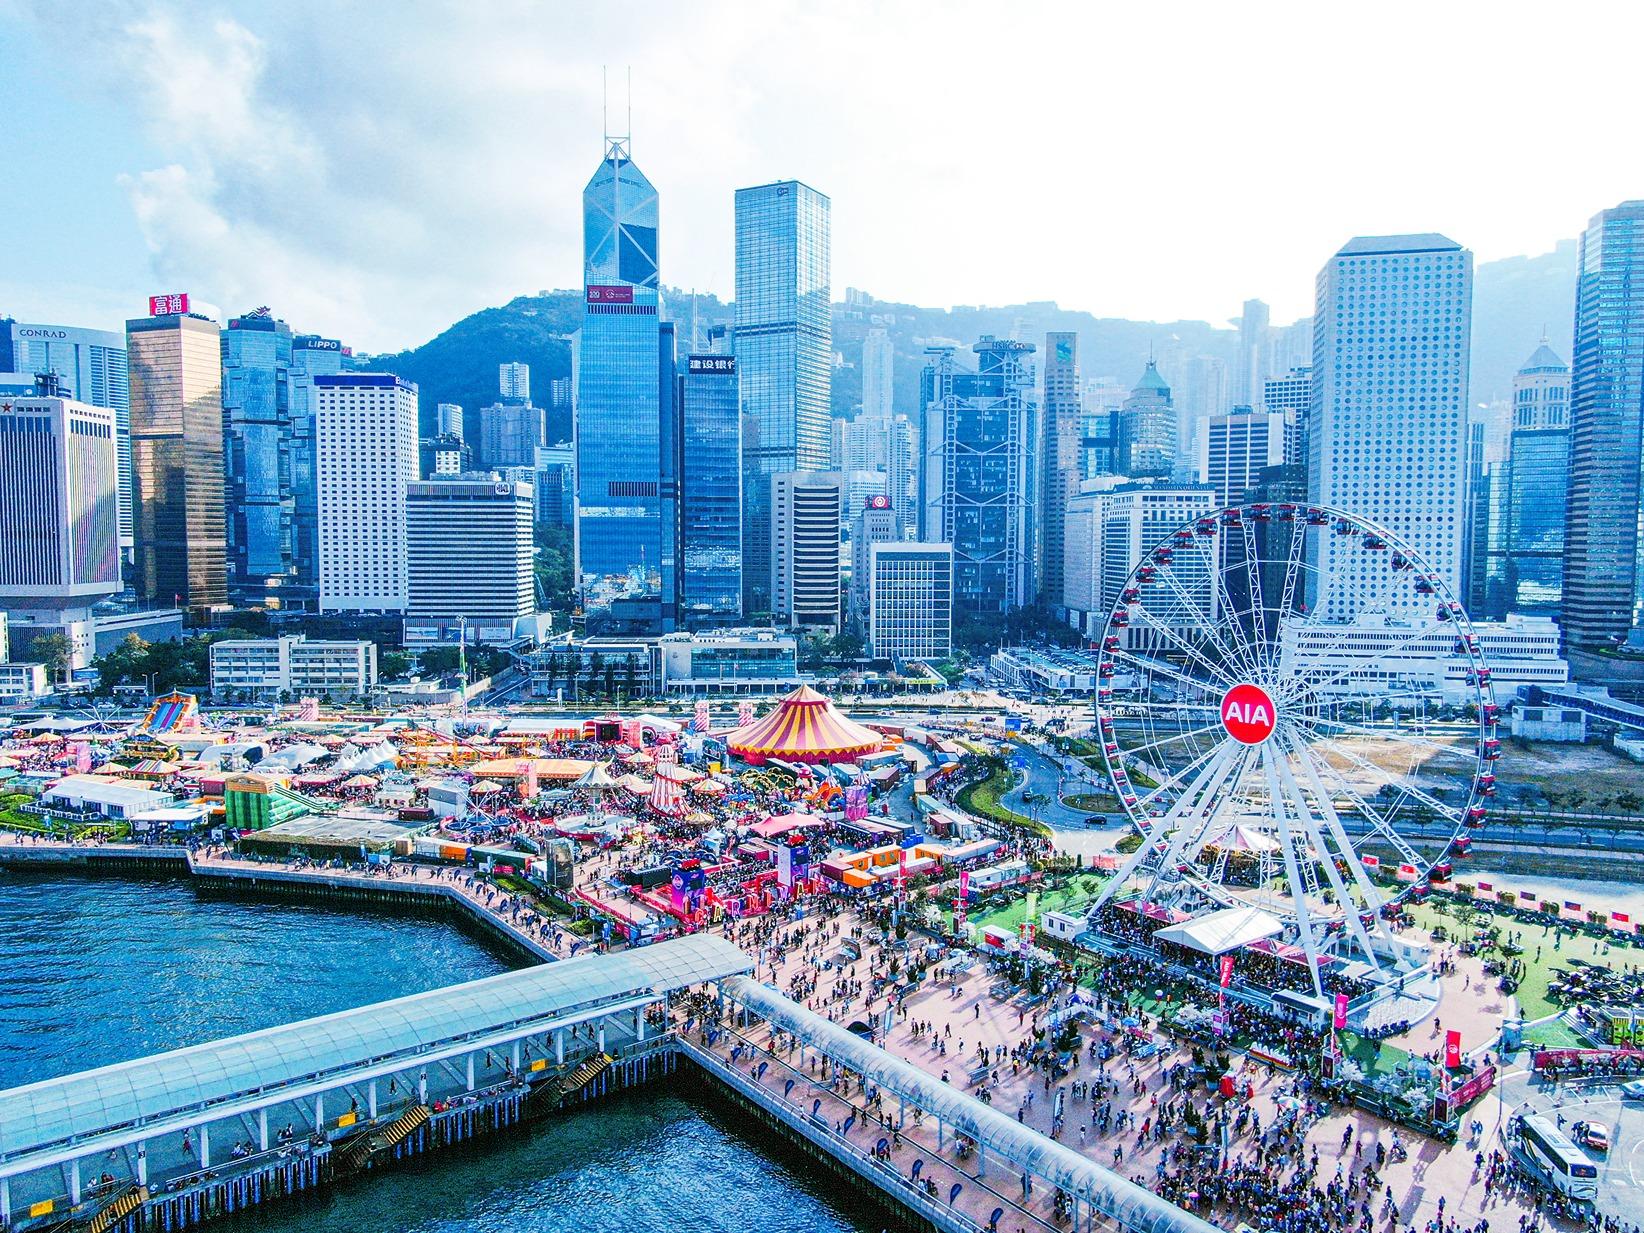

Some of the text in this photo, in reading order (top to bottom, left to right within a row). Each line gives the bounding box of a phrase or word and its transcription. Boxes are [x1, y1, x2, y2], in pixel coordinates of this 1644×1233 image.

[155, 294, 182, 315] 富通
[19, 329, 67, 339] CONRAD
[308, 340, 338, 349] LIPPO
[1225, 701, 1270, 727] AIA
